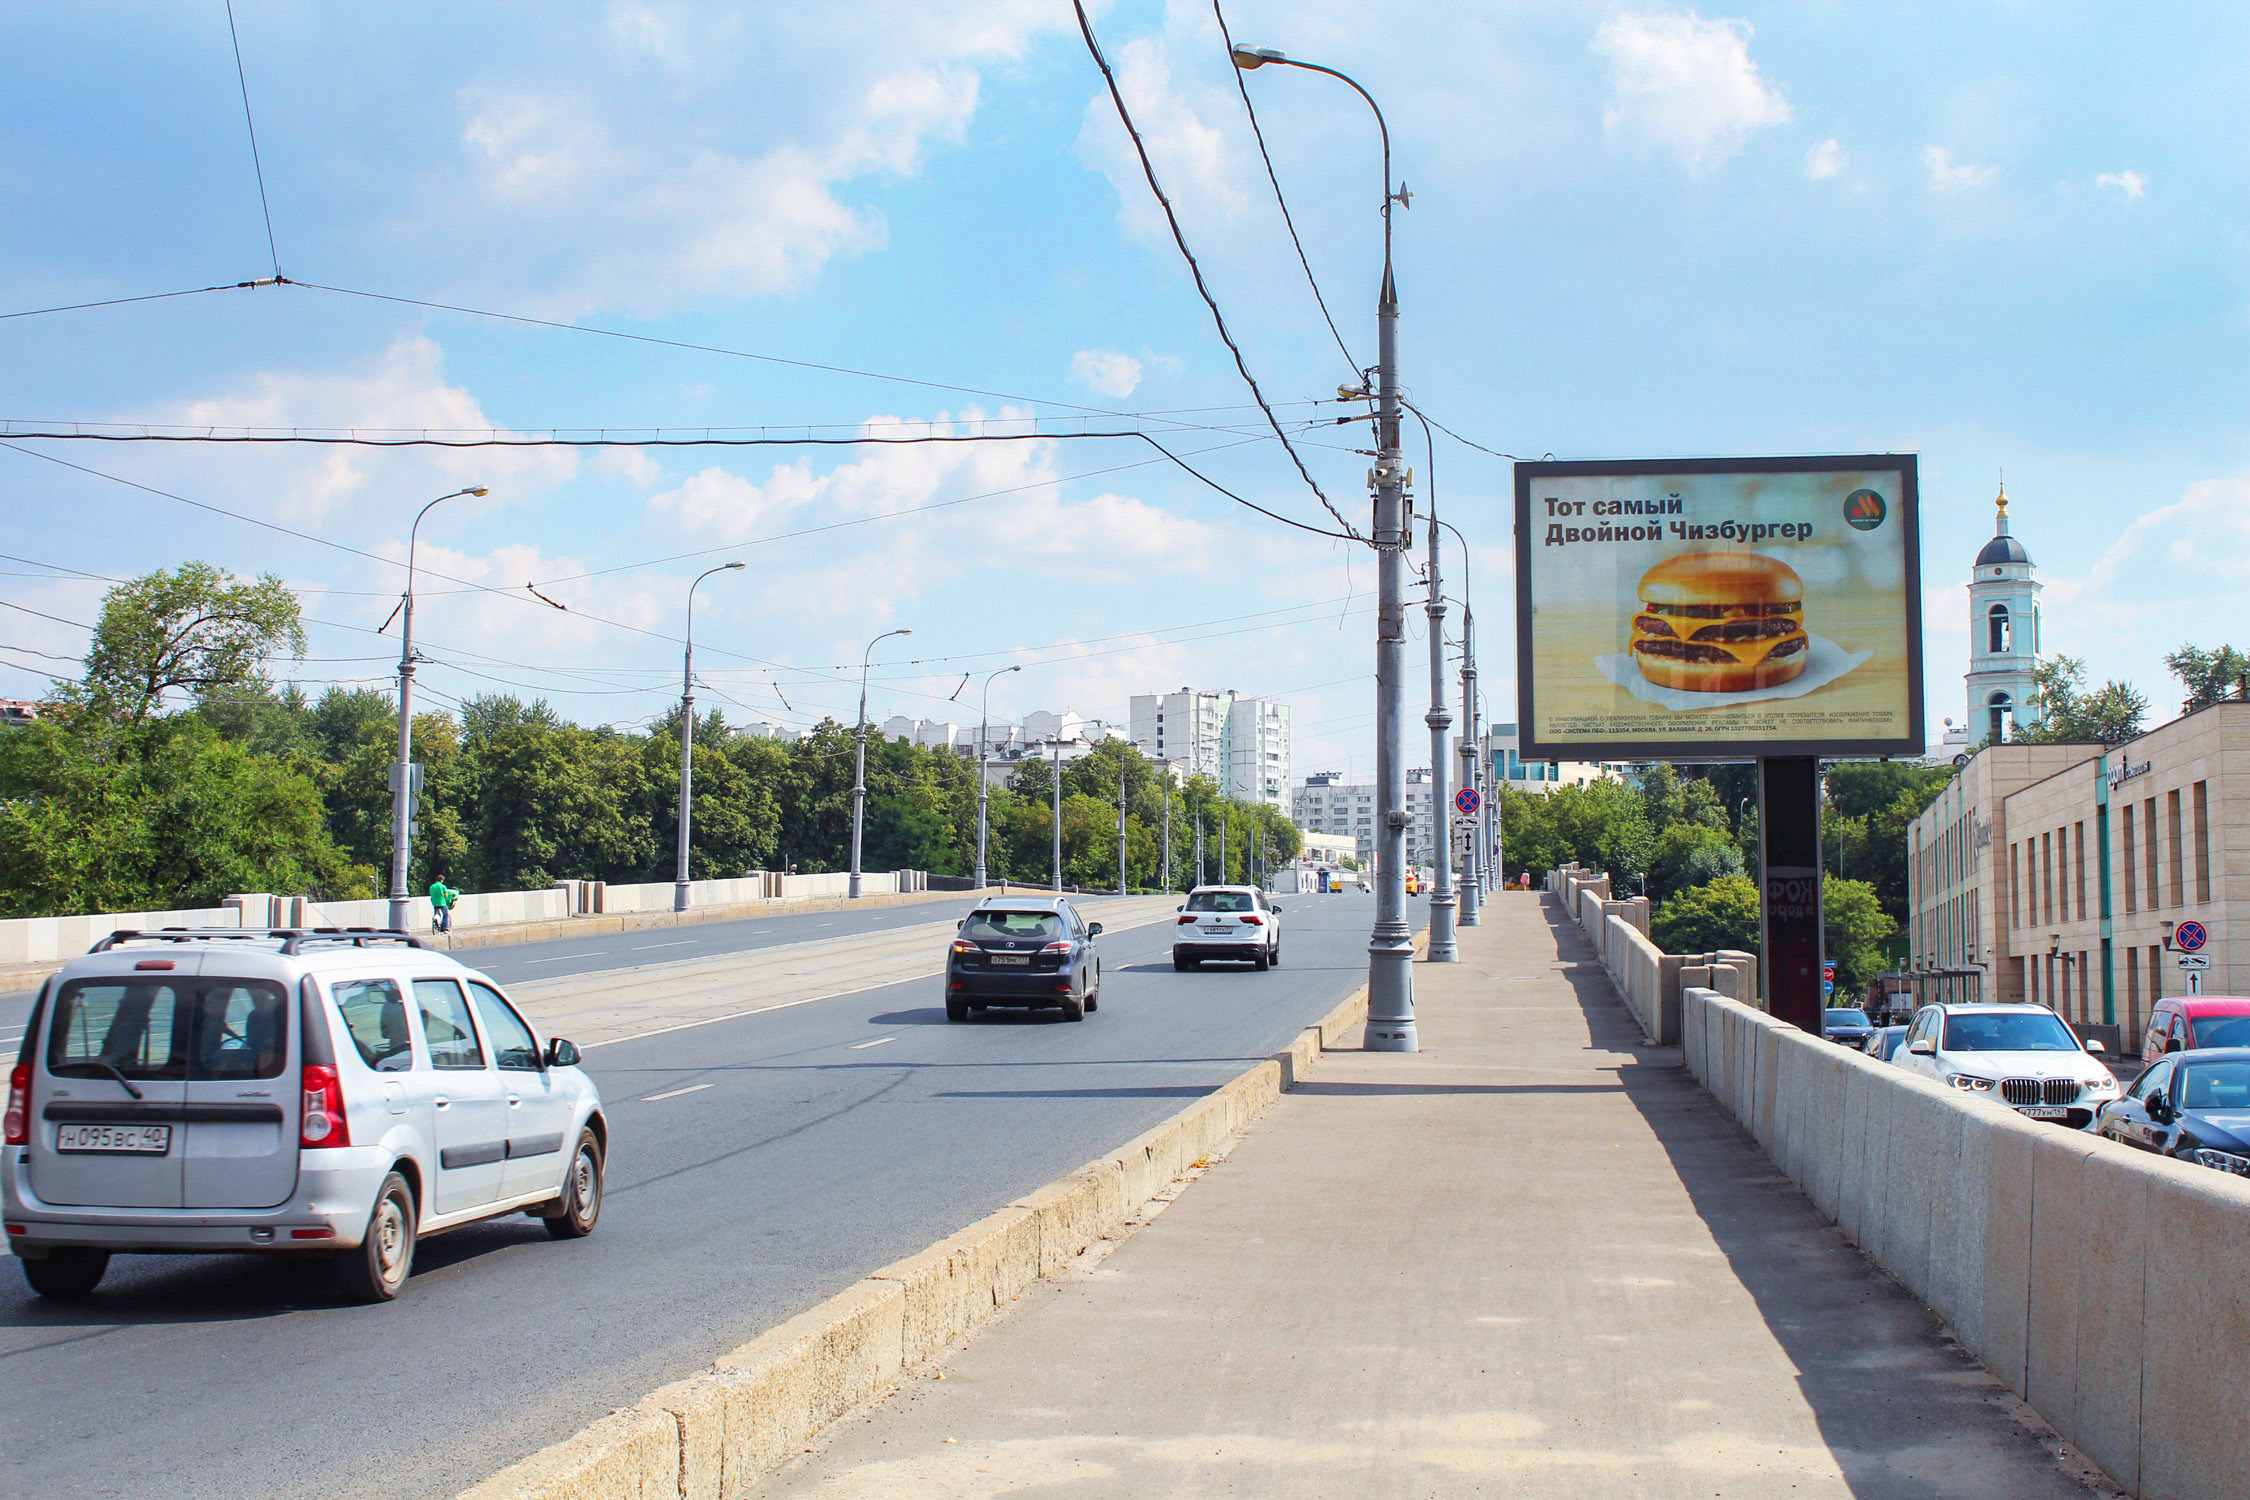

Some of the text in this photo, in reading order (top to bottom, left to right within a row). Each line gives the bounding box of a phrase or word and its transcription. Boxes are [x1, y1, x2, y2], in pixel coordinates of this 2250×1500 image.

[1544, 493, 1683, 516] Тот самый
[1545, 520, 1813, 546] Двойной Чизбургер
[64, 1128, 162, 1147] Н095ВС 40
